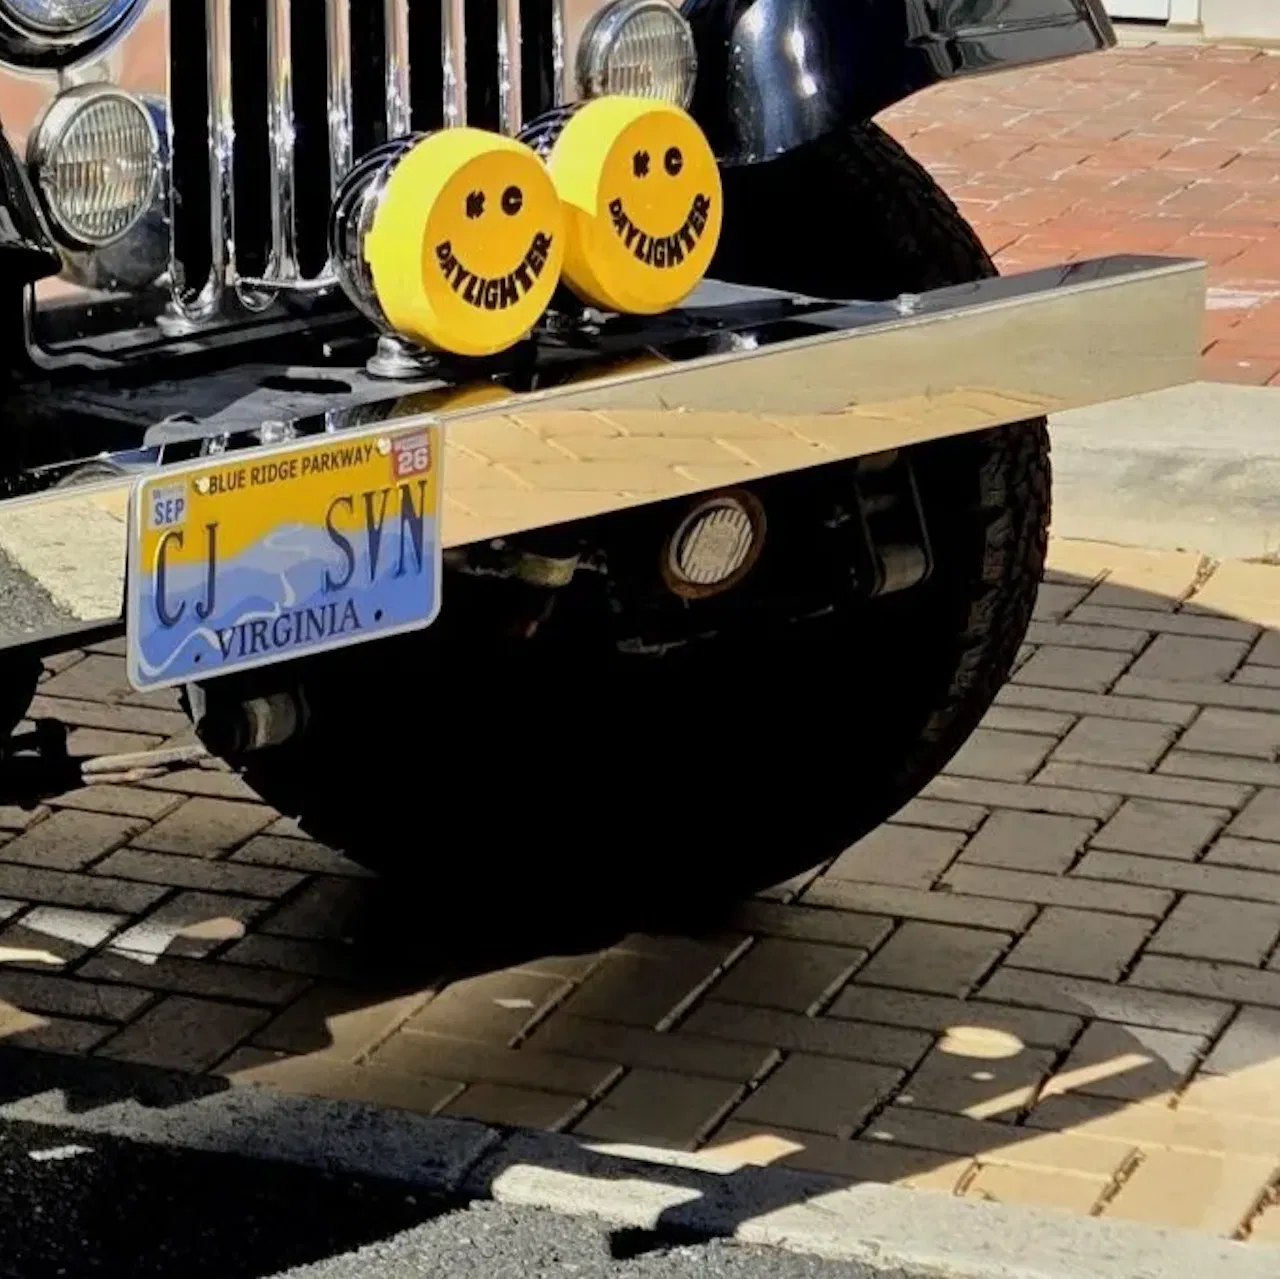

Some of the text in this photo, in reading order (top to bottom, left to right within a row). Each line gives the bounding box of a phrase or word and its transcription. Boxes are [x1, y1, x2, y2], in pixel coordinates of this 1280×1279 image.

[609, 193, 711, 269] DAYLIGHTER
[435, 231, 553, 310] DAYLIGHTER
[208, 443, 374, 496] BLUE RIDGE PARKWAY
[397, 447, 429, 476] 26
[154, 497, 184, 526] SEP
[153, 479, 428, 629] CJ SVN
[215, 598, 364, 662] VIRGINIA
